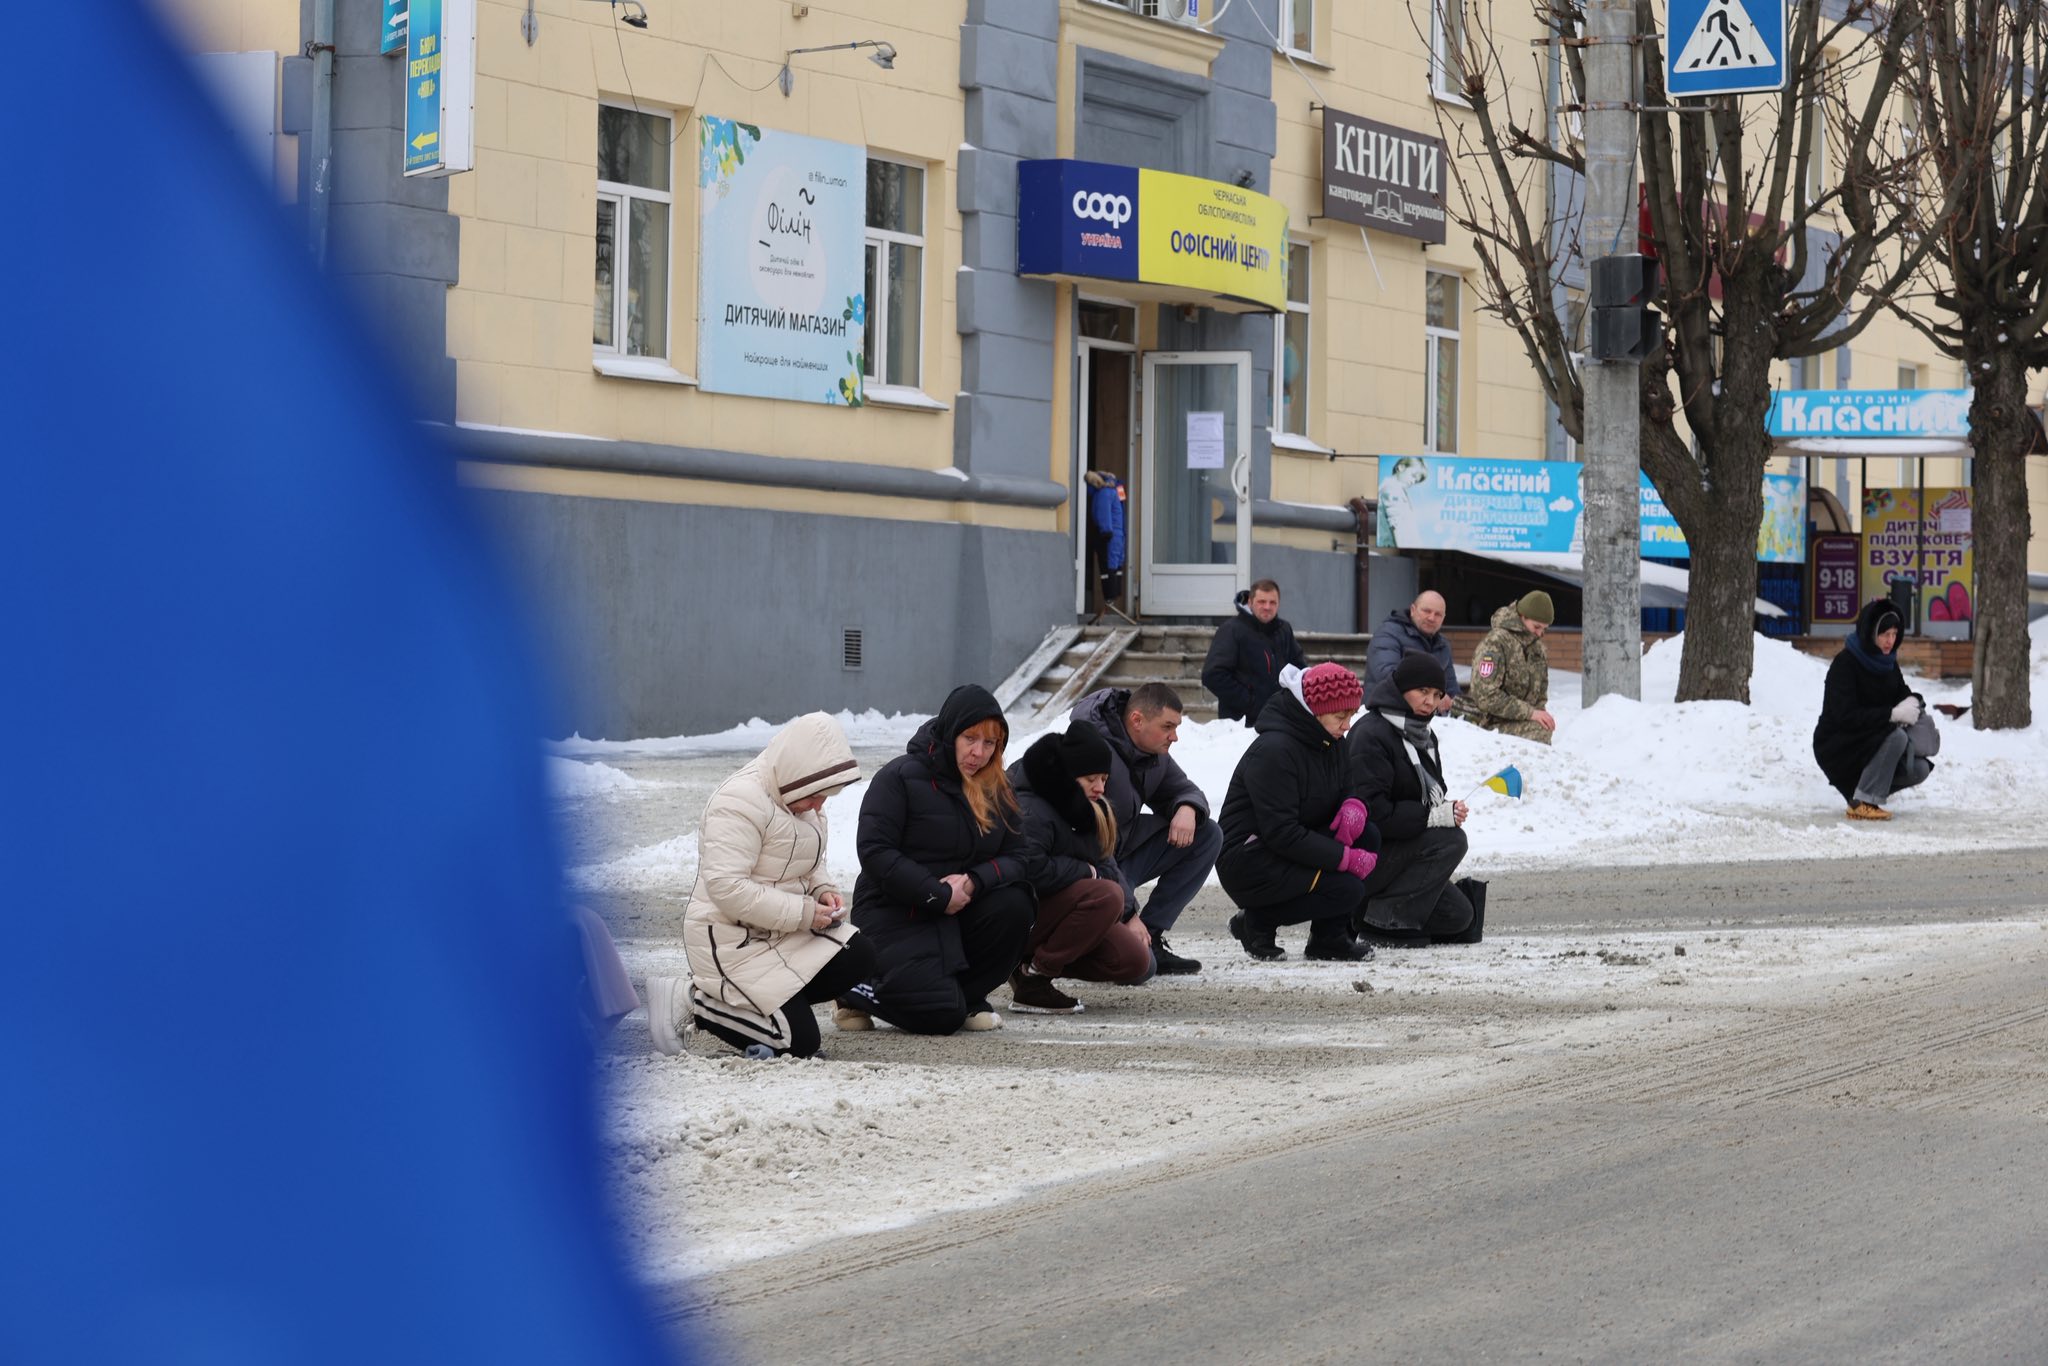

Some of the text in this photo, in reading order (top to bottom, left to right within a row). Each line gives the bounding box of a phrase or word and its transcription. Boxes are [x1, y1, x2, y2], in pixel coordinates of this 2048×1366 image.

[1335, 122, 1439, 194] КНИГИ
[1213, 188, 1247, 206] ЧЕРКАСЬКА
[1328, 184, 1445, 222] канцтовари ксерокопія
[1081, 232, 1123, 249] УКРАЇНА
[1171, 230, 1238, 263] ОФІСНИЙ
[725, 304, 846, 337] ДИТЯЧИЙ МАГАЗИН
[744, 352, 828, 371] Найкраще для найменших
[1829, 395, 1911, 404] магазин
[1468, 466, 1522, 474] магазин
[1437, 466, 1551, 493] Класний
[1885, 521, 1941, 533] ДИТЧ
[1870, 550, 1962, 566] ВЗУТТЯ
